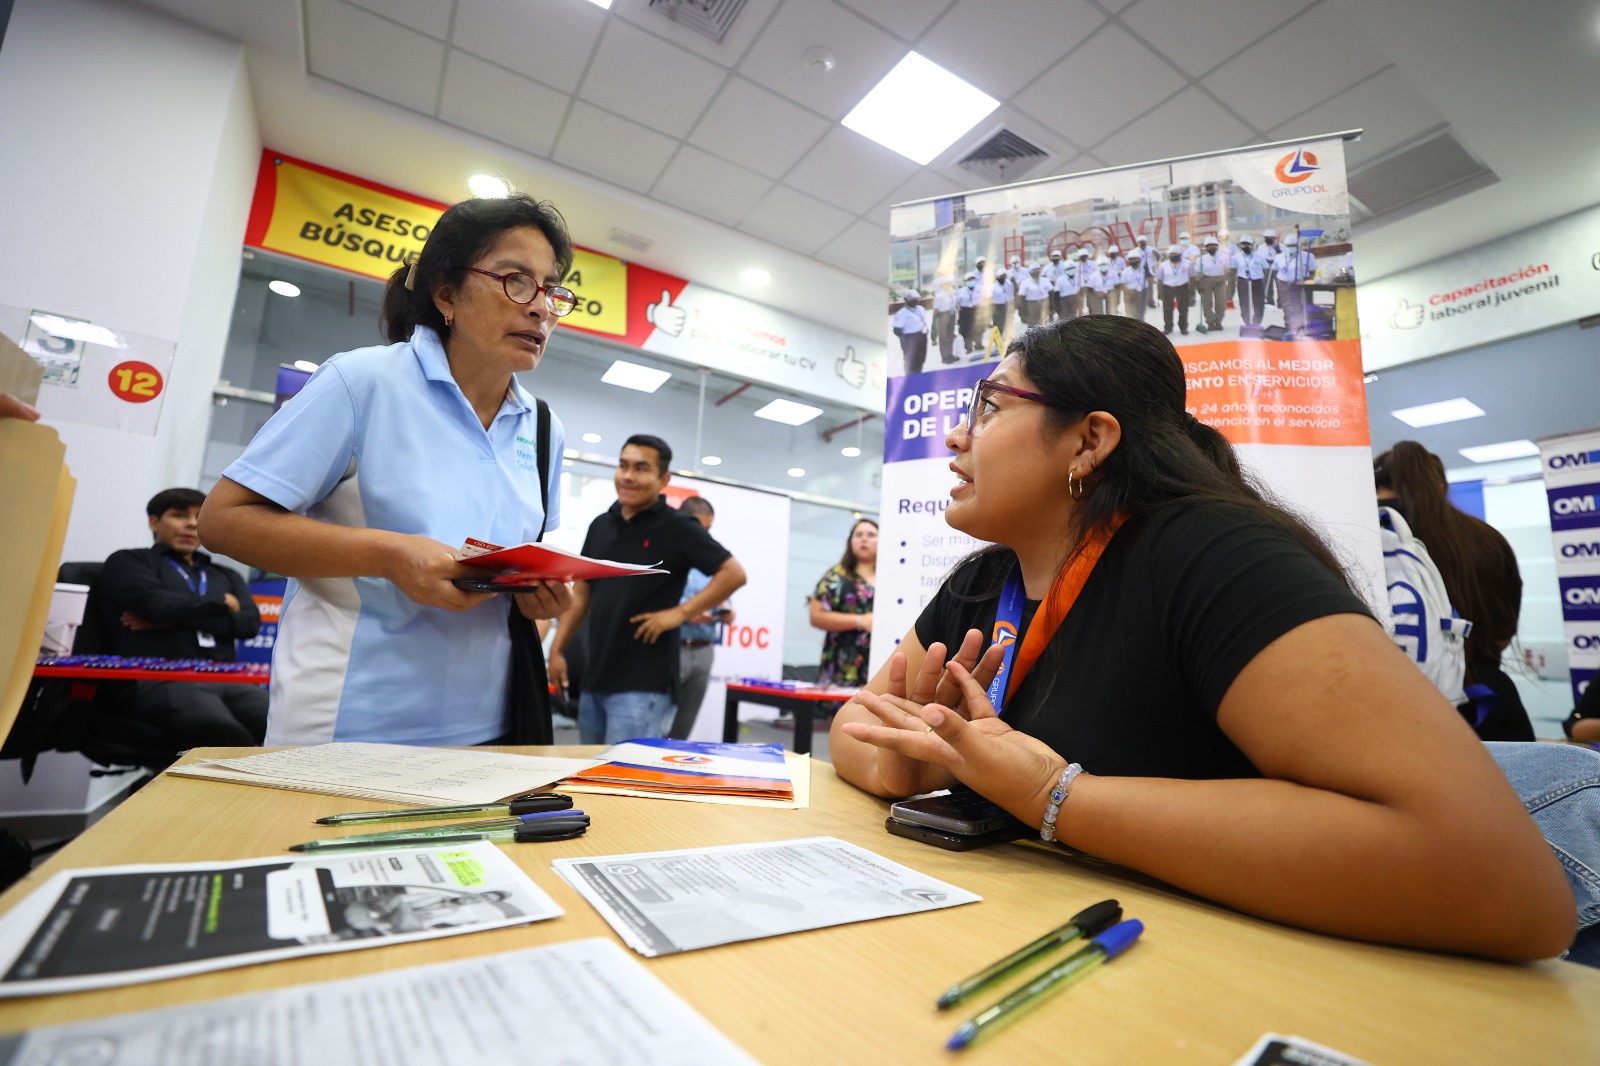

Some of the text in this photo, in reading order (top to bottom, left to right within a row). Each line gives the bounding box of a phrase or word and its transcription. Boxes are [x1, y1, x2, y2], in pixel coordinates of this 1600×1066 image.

[1272, 184, 1328, 199] GRUPO OL
[333, 202, 430, 241] ASESO
[1429, 262, 1550, 306] Capacitación
[1431, 275, 1560, 322] laboral juvenil
[784, 353, 797, 365] tu
[799, 356, 817, 370] CV
[1256, 359, 1276, 371] AL
[1278, 359, 1335, 371] MEJOR
[116, 368, 158, 397] 12
[1228, 375, 1248, 387] EN
[1254, 375, 1336, 388] SERVICIOS!
[904, 388, 973, 415] OPER
[1200, 403, 1218, 415] 24
[1259, 403, 1340, 414] reconocidos
[903, 416, 937, 440] DE
[1254, 418, 1271, 427] en
[1274, 416, 1285, 427] el
[1289, 417, 1341, 428] servicio
[899, 499, 949, 515] Requ
[923, 534, 944, 547] Ser
